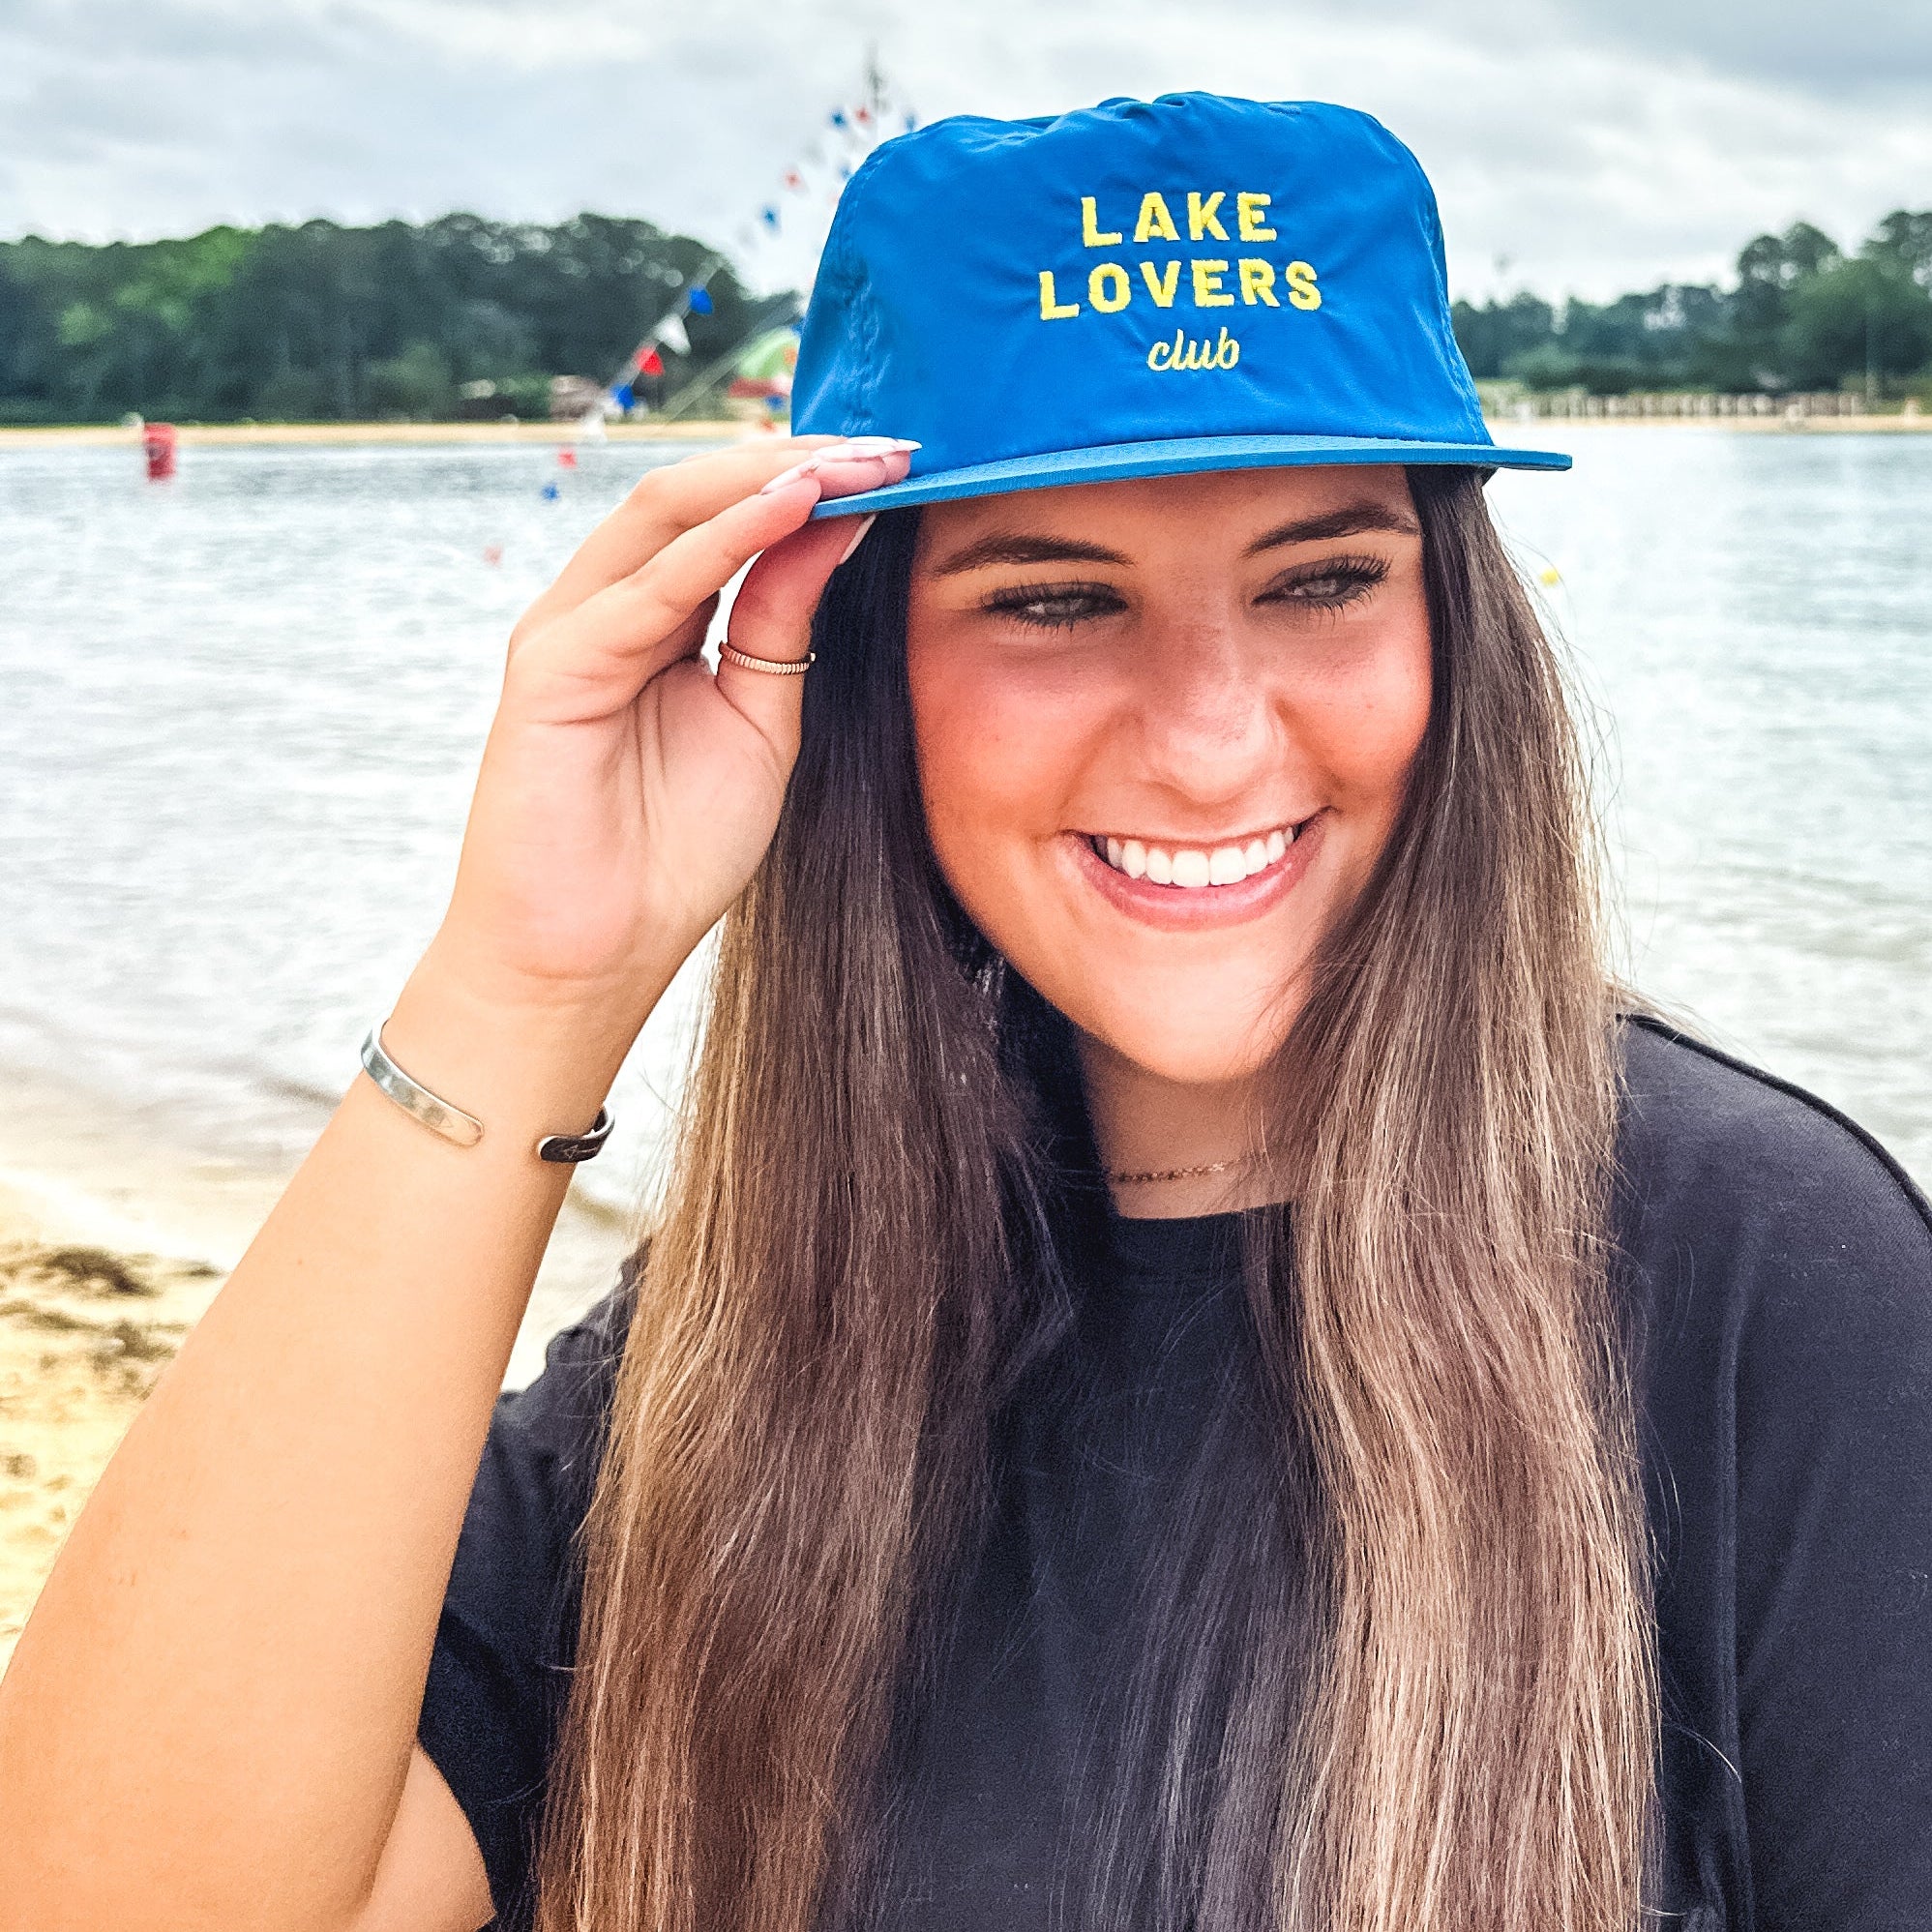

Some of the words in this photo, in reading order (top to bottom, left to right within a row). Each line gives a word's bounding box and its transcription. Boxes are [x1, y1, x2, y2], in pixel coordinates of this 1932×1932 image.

[1081, 192, 1277, 248] LAKE
[1038, 258, 1323, 321] LOVERS
[1147, 326, 1240, 372] club
